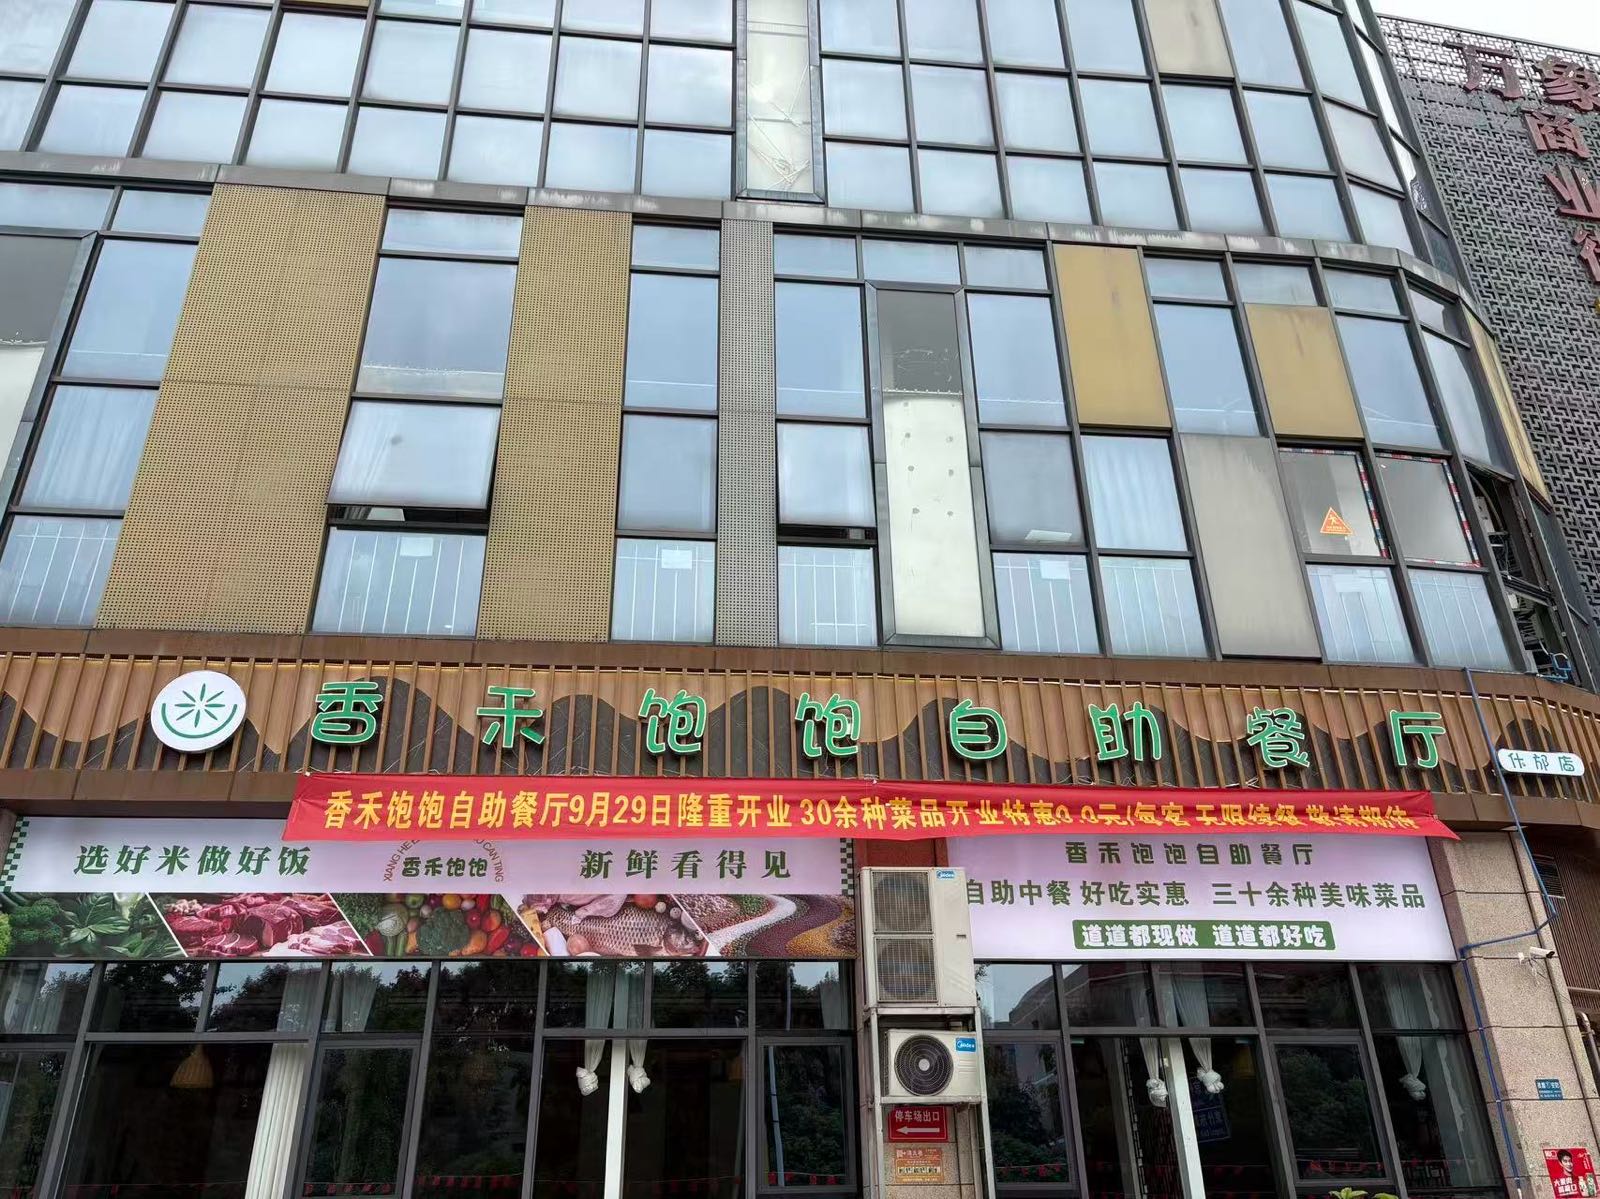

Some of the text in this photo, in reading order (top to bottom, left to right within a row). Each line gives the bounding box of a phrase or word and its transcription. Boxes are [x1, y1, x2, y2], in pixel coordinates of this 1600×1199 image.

[310, 681, 1446, 770] 香禾饱饱自助餐厅
[324, 789, 793, 830] 香禾饱饱自助餐厅9月29日隆重开业
[73, 844, 311, 875] 选好米做好饭
[383, 853, 401, 882] XIANG
[482, 841, 500, 861] CAN
[493, 861, 504, 883] TING
[402, 857, 487, 877] 香禾饱饱
[579, 849, 791, 879] 新鲜看得见
[1065, 842, 1312, 865] 香禾饱饱自助餐厅
[966, 879, 1425, 908] 自助中餐 好吃实惠 三十余种美味菜品
[1081, 923, 1328, 948] 道道都现做 道道都好吃
[895, 1110, 940, 1122] 停车场出口
